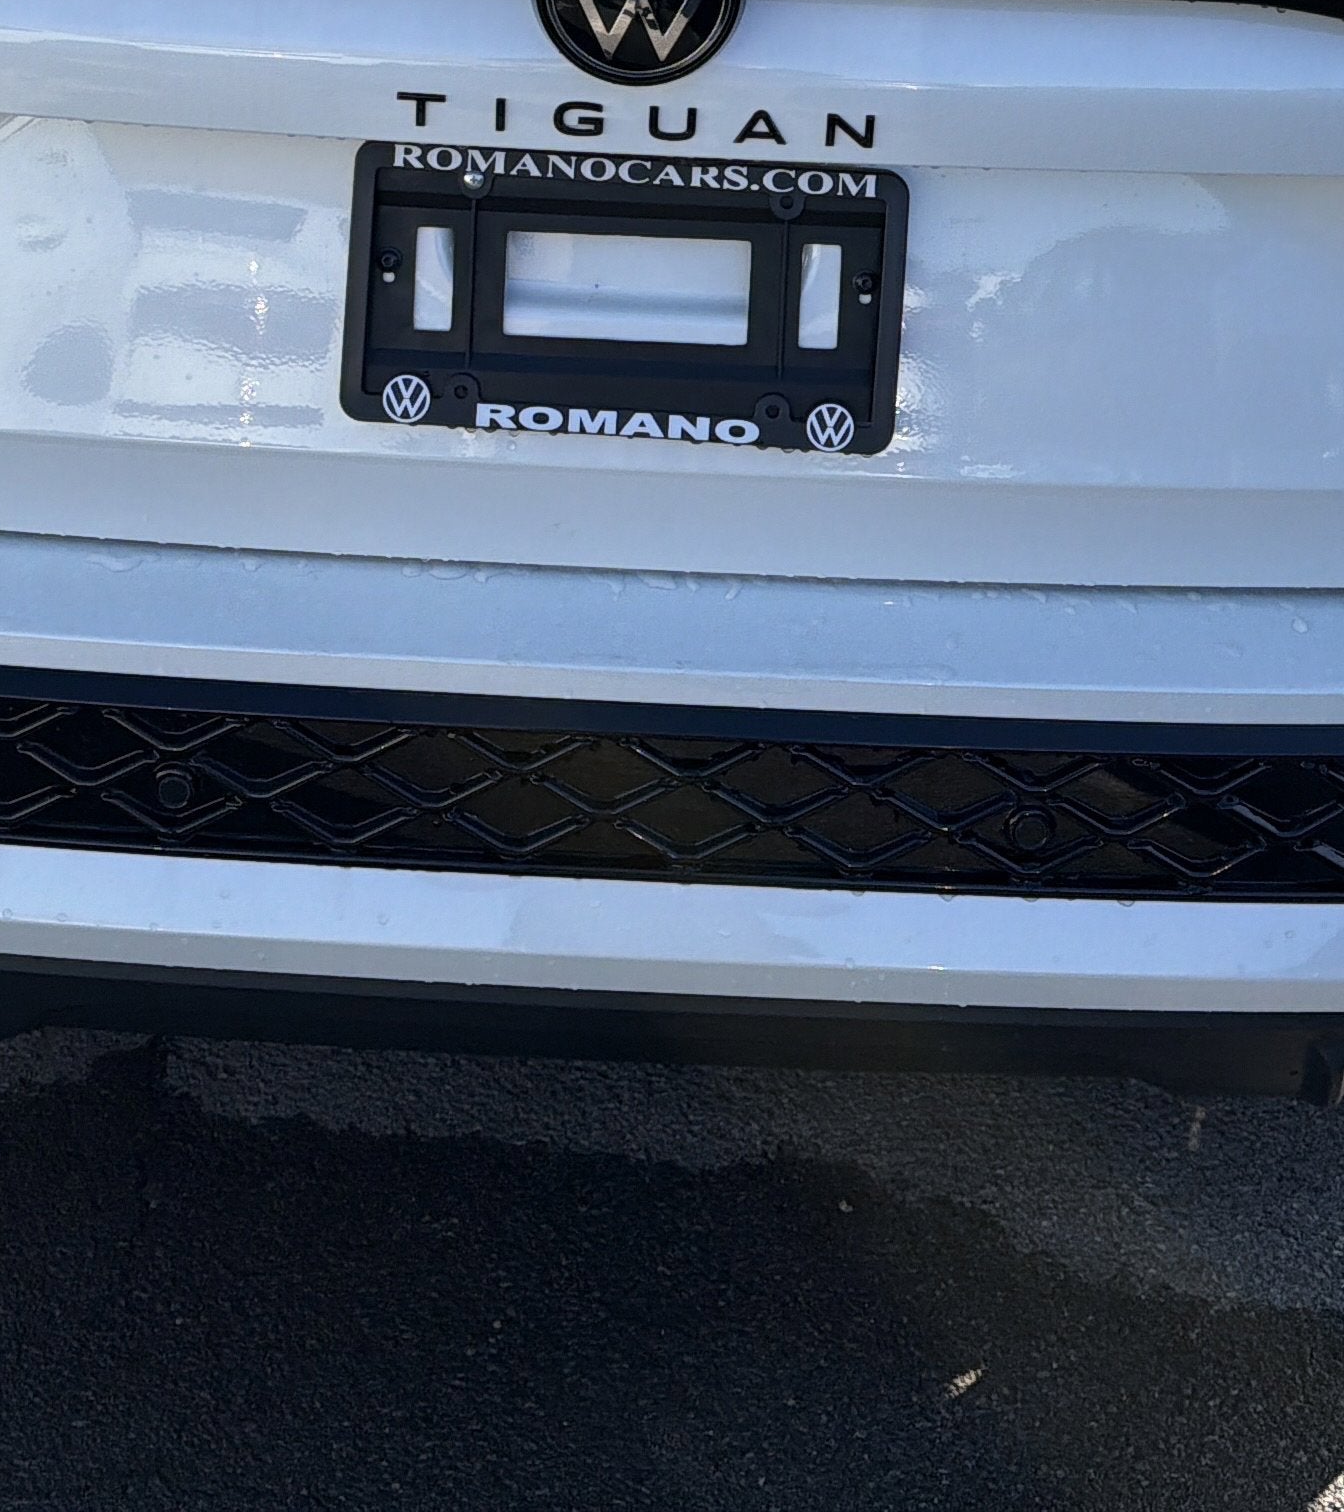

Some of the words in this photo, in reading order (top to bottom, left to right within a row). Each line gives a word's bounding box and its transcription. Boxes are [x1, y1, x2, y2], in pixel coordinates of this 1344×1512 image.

[396, 91, 876, 149] TIGUAN
[392, 143, 878, 199] ROMANOCARS.COM
[382, 374, 431, 424] VW
[474, 402, 760, 445] ROMANO
[806, 403, 855, 452] VW
